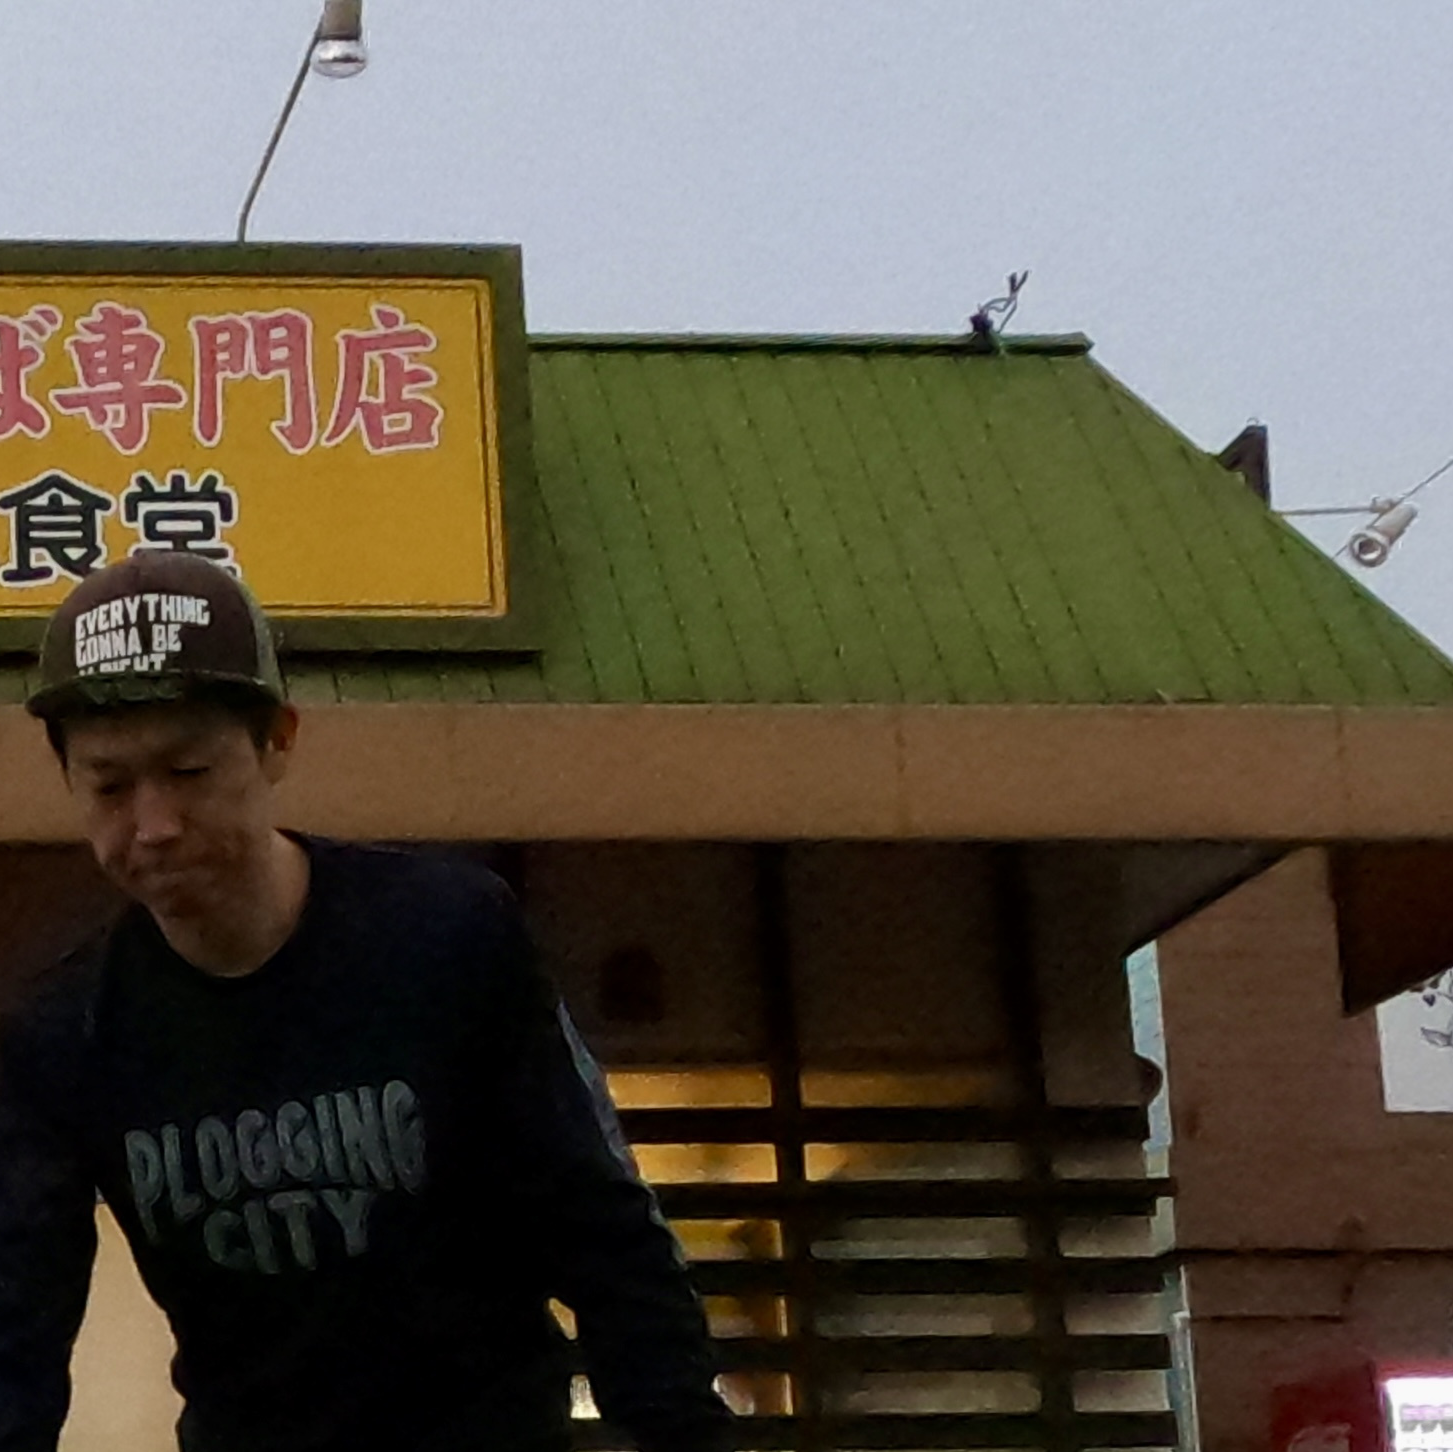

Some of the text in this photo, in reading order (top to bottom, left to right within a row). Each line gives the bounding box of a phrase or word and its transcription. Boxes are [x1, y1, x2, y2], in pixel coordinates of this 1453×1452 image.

[75, 593, 210, 640] EVERYTHING
[75, 626, 142, 668] GONNA
[152, 624, 182, 652] BE
[124, 1079, 427, 1245] PLOGGING
[203, 1188, 371, 1275] CITY
